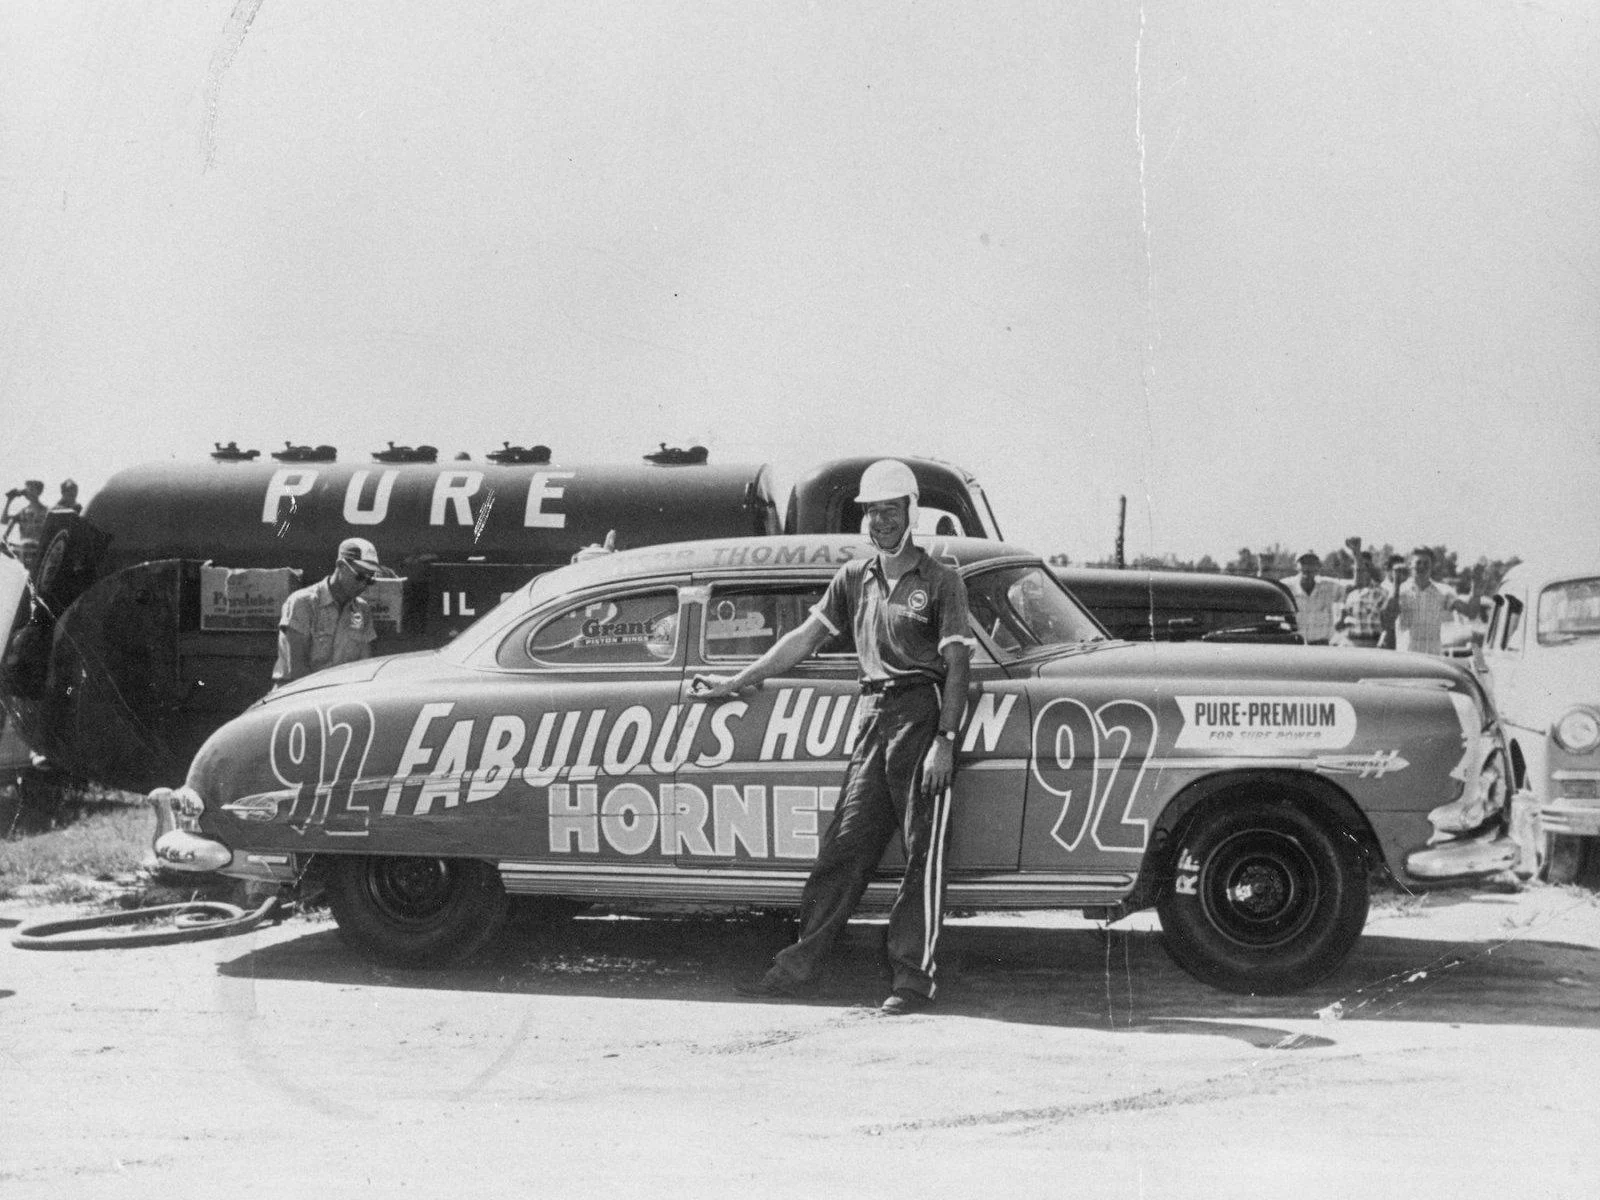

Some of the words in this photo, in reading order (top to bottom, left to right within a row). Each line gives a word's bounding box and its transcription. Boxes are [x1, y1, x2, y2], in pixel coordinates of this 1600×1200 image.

[262, 469, 576, 528] PURE
[709, 545, 856, 565] THOMAS
[582, 618, 655, 638] Grant
[585, 637, 618, 645] PISTON
[1195, 702, 1336, 727] PURE-PREMIUM
[270, 701, 375, 836] 92
[382, 701, 749, 815] FABULOUS
[1032, 698, 1158, 854] 92
[1175, 848, 1200, 895] RF
